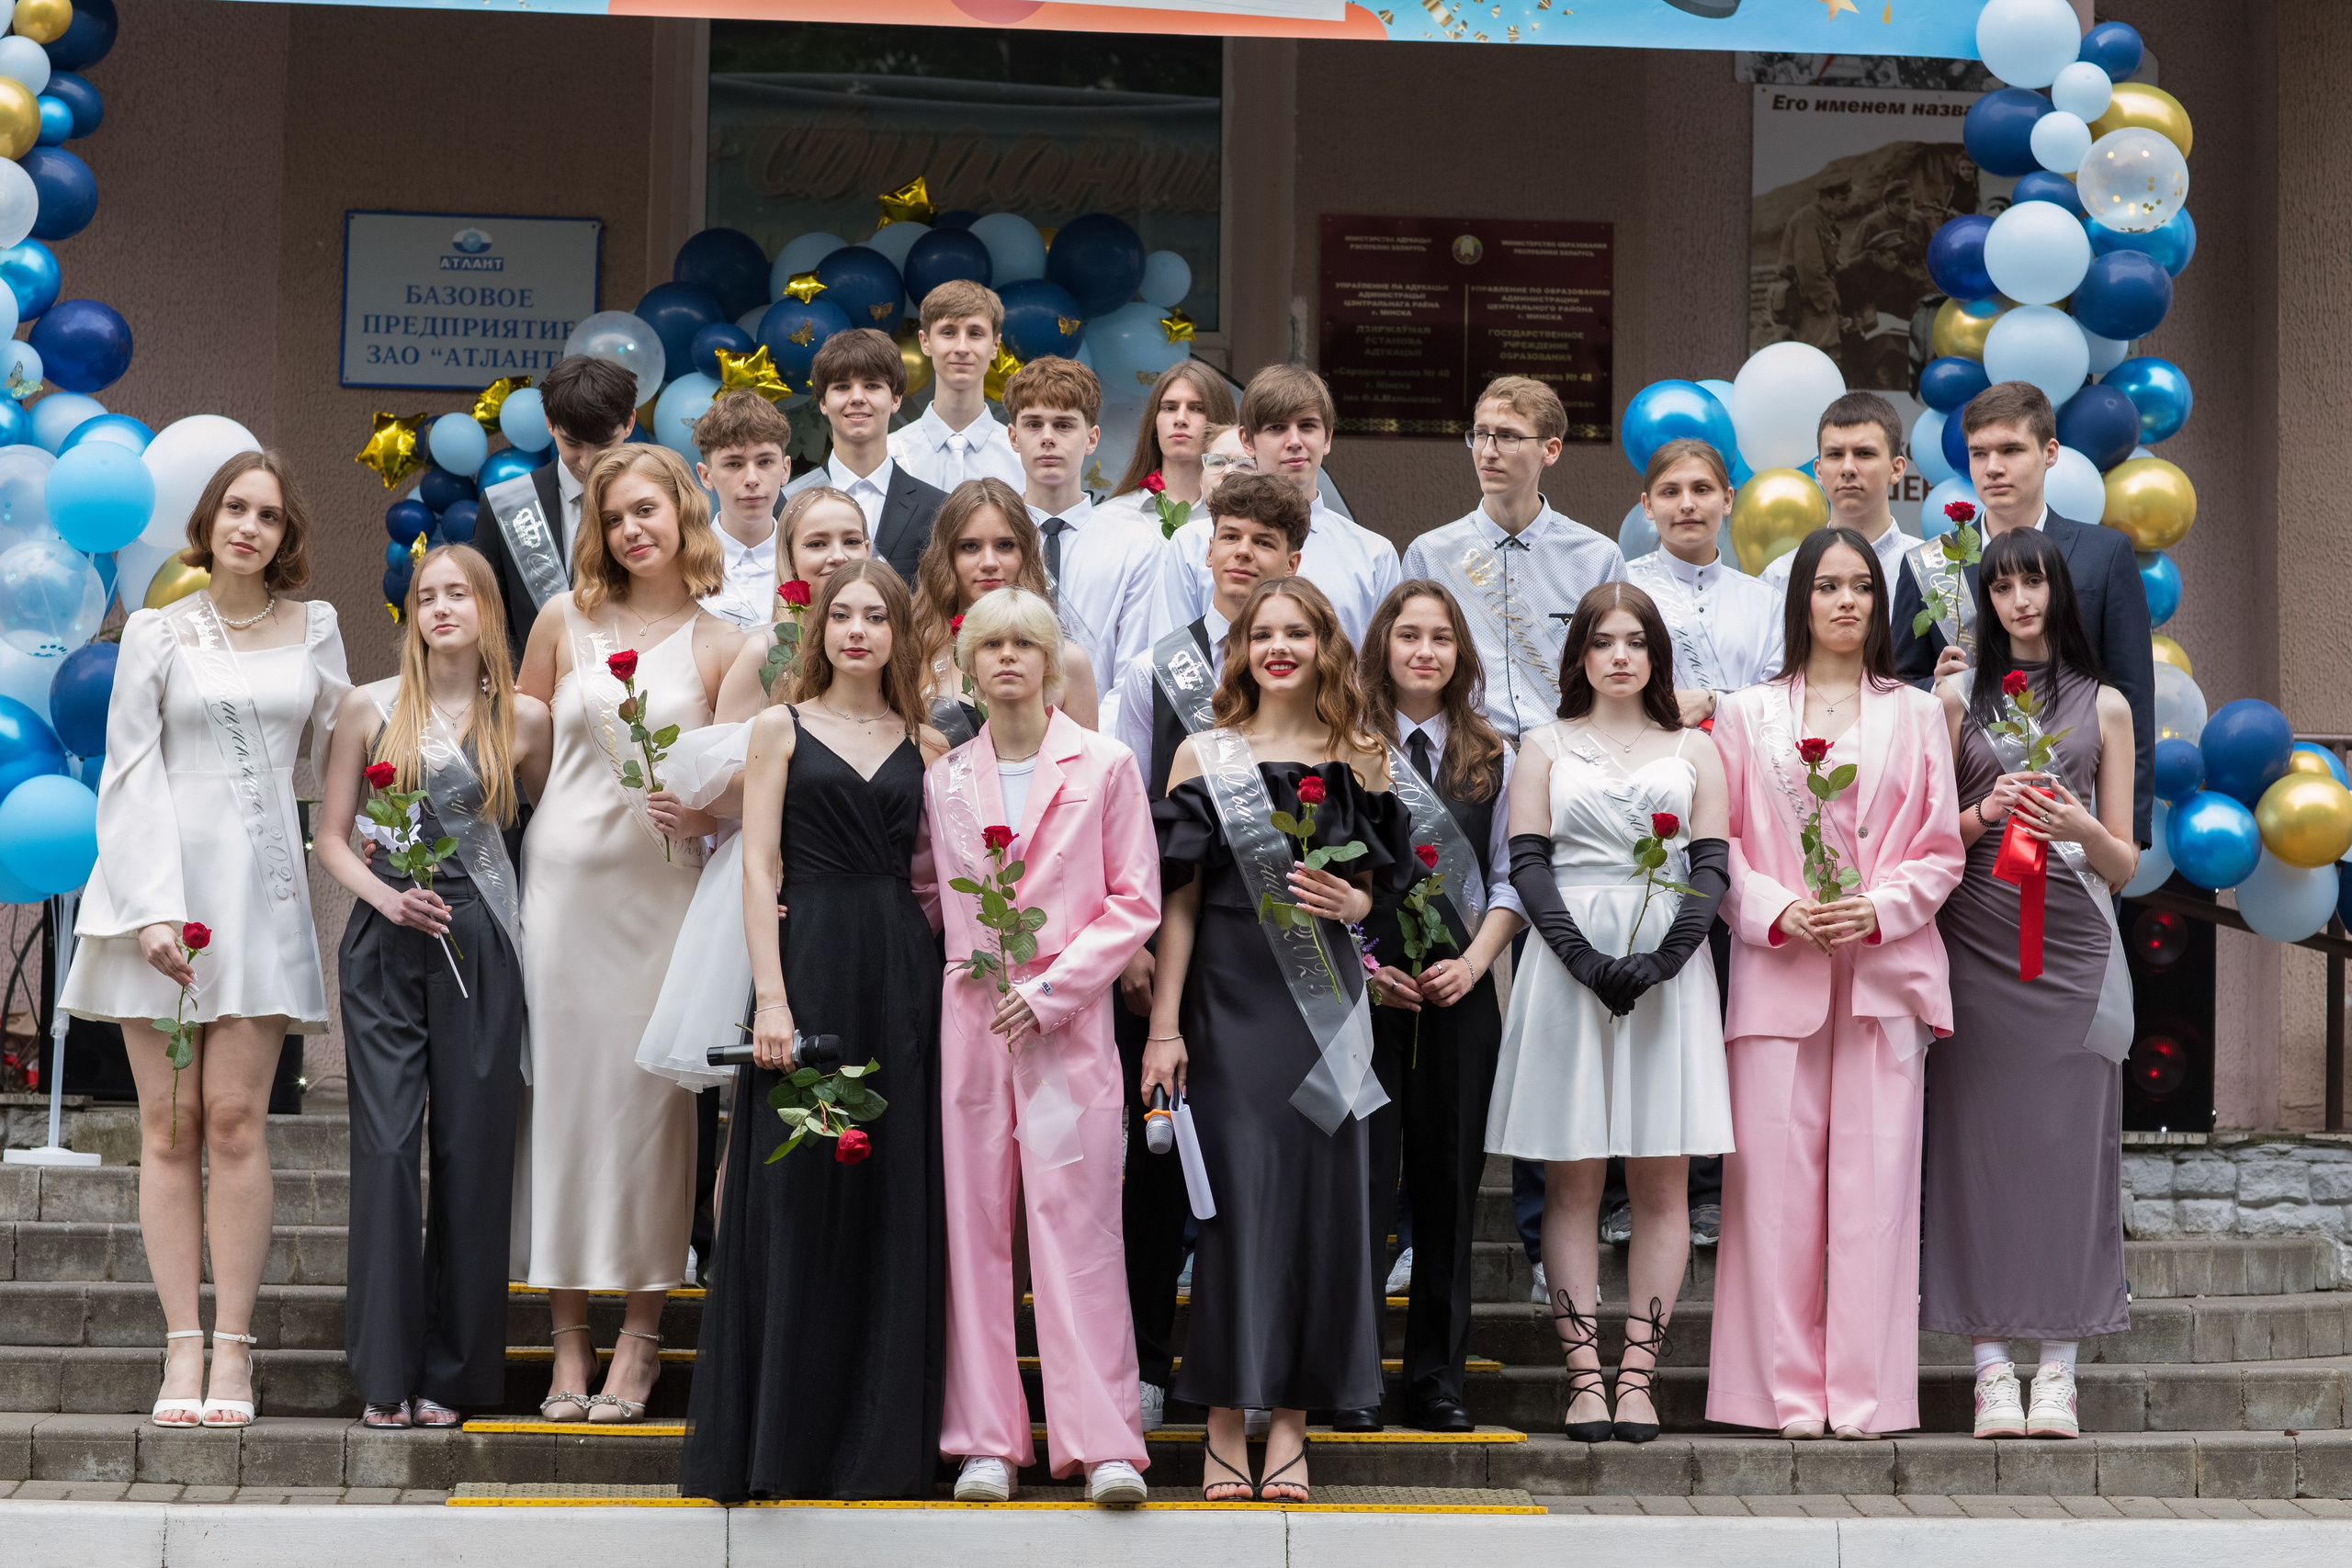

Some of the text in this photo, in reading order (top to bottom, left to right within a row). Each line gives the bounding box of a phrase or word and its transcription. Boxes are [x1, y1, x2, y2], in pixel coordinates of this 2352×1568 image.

[1772, 95, 1808, 111] Его
[1815, 98, 1905, 115] именем
[440, 257, 503, 271] АТЛАНТ
[1471, 286, 1527, 294] УПРАВЛЕНИЕ
[1544, 288, 1611, 296] ОБРАЗОВАНИЮ
[405, 285, 534, 308] БАЗОВОЕ
[1501, 295, 1579, 304] АДМИНИСТРАЦИИ
[1487, 303, 1594, 313] ЦЕНТРАЛЬНОГО РАЙОНА
[363, 314, 575, 340] ПРЕДПРИЯТИЕ
[1487, 329, 1584, 340] ГОСУДАРСТВЕННОЕ
[1502, 341, 1570, 350] УЧРЕЖДЕНИЕ
[367, 345, 420, 365] ЗАО
[1364, 348, 1422, 357] АДУКАЦЫІ
[1499, 352, 1572, 361] ОБРАЗОВАНИЯ
[1580, 373, 1593, 382] 48
[255, 823, 301, 904] 2025
